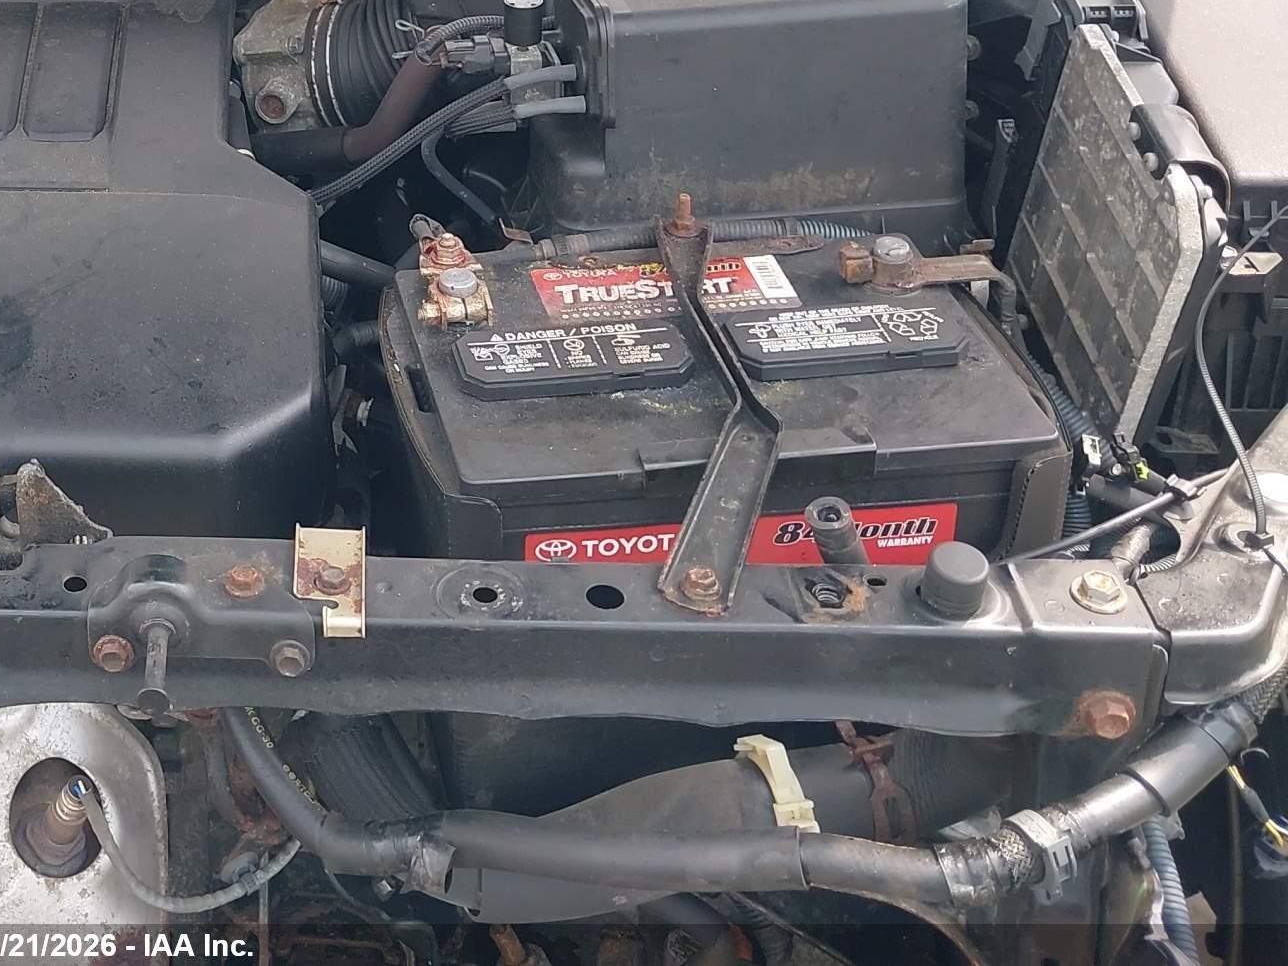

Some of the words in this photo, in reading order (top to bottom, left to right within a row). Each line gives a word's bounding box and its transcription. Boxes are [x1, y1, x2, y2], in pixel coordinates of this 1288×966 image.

[554, 277, 732, 304] TRUESTRT
[504, 328, 564, 342] DANGER
[580, 323, 637, 335] POISON
[855, 517, 939, 539] onth
[581, 533, 676, 557] TOYOT
[877, 536, 933, 548] WARRANTY
